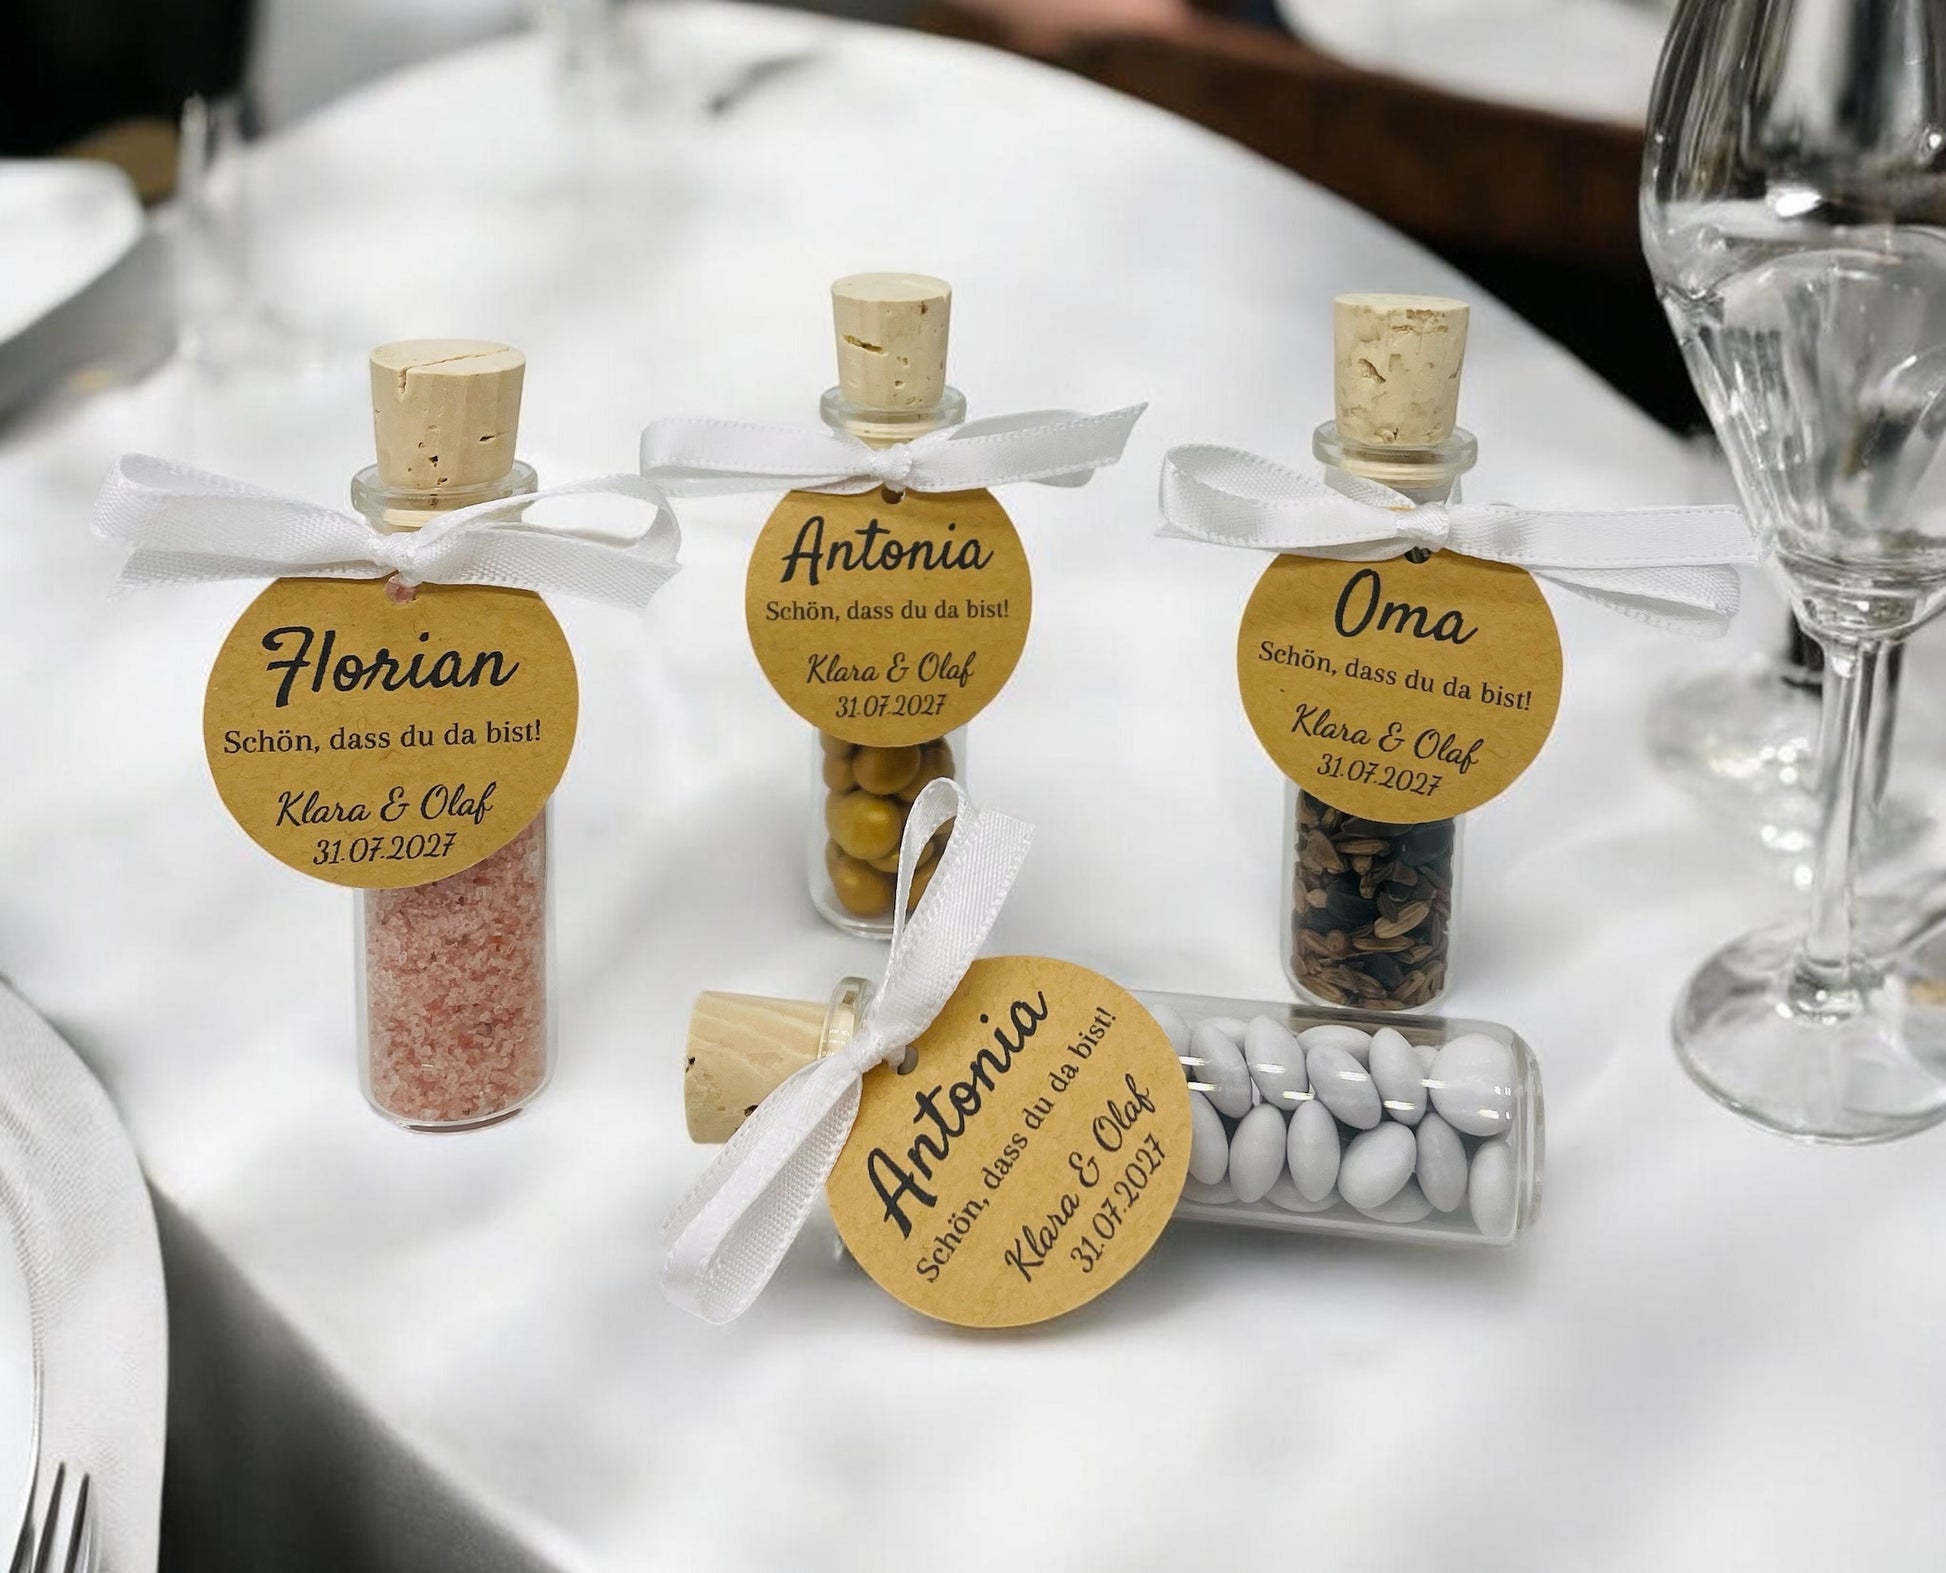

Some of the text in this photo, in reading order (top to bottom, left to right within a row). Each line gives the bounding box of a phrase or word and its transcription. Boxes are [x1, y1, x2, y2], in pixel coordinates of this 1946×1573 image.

[779, 515, 995, 587] Antonia
[765, 599, 1009, 623] Schön, dass du da bist!
[1333, 567, 1479, 646] Oma
[261, 625, 520, 709] Florian
[806, 651, 977, 688] Klara & Olaf
[1258, 640, 1533, 711] Schön, dass du da bist!
[223, 718, 542, 755] Schön, dass du da bist!
[835, 693, 947, 718] 31.07.2027
[1290, 703, 1485, 775] Klara & Olaf
[275, 781, 498, 827] Klara & Olaf
[1316, 753, 1443, 797] 31.07.2027
[312, 832, 458, 866] 31.07.2027
[866, 990, 1050, 1240] Antonia
[915, 1006, 1117, 1284] Schön, dass du da bist!
[1003, 1073, 1157, 1284] Klara & Olaf
[1070, 1132, 1167, 1274] 31.07.2027
